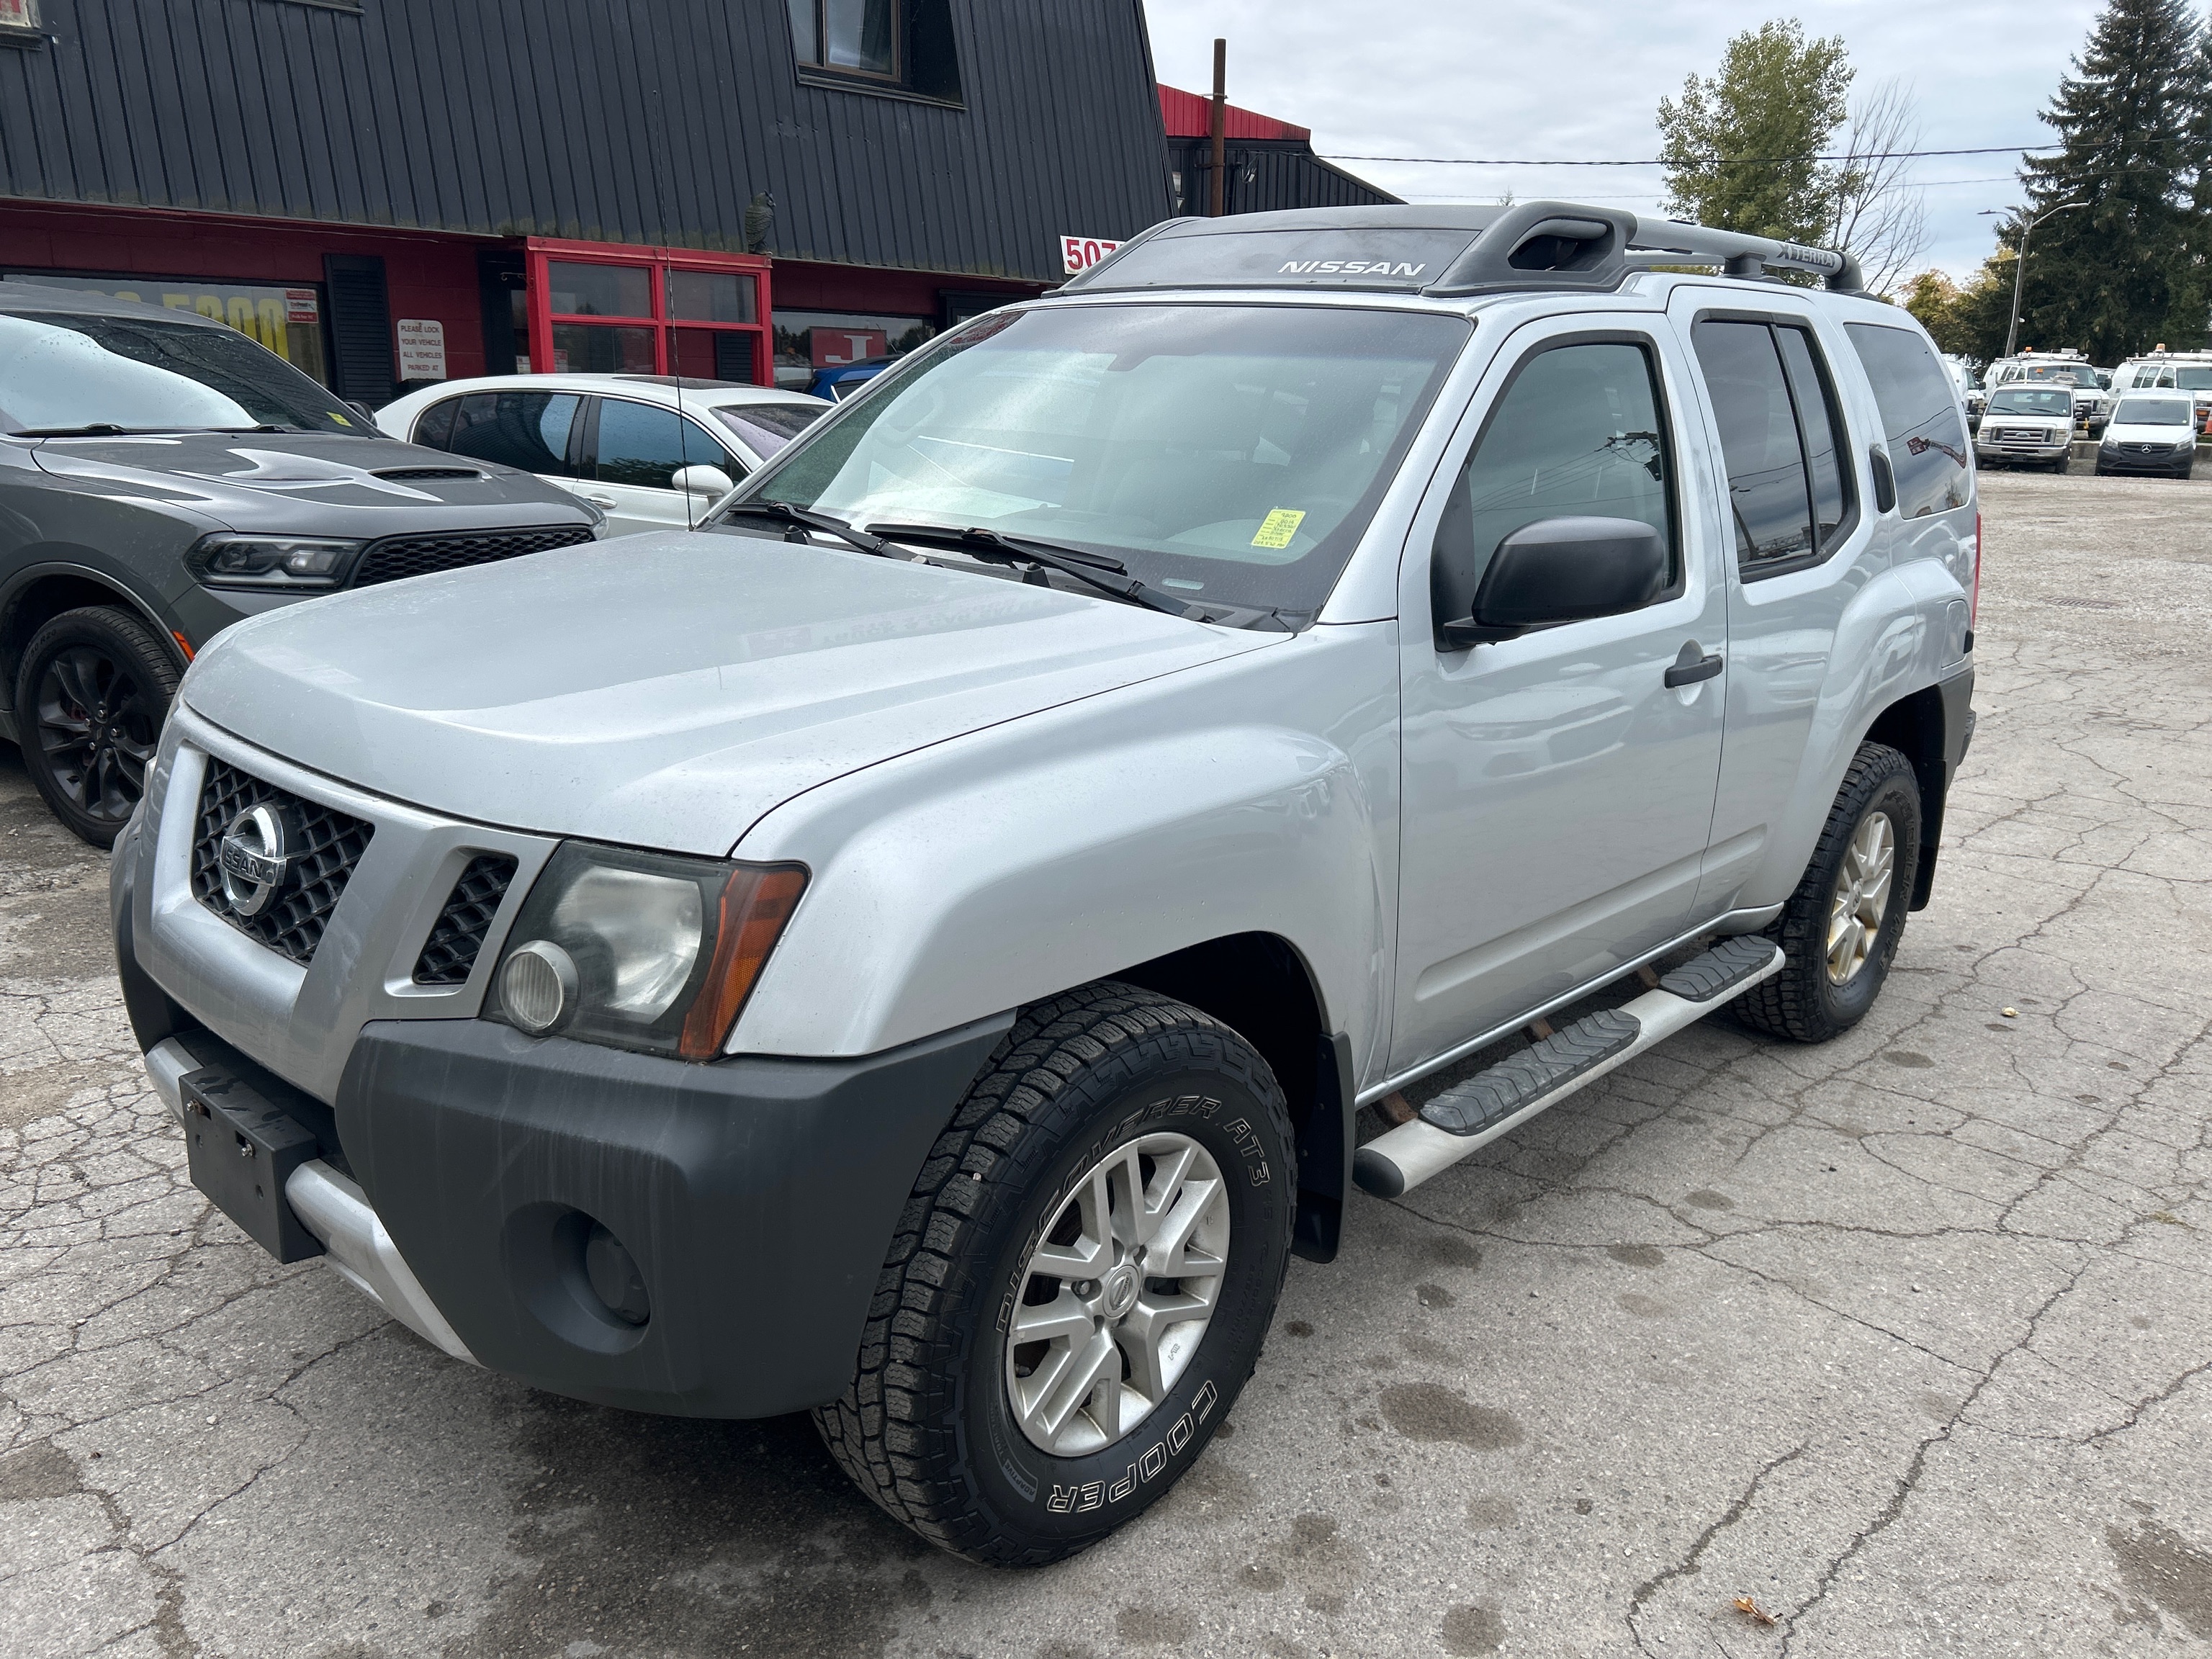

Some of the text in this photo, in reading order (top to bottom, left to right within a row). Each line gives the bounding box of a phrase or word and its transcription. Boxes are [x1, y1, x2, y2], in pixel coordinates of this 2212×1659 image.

[1277, 261, 1426, 276] NISSAN
[1776, 243, 1834, 266] XTERRA
[1223, 1118, 1270, 1187] AT3
[1047, 1380, 1218, 1513] COOPER
